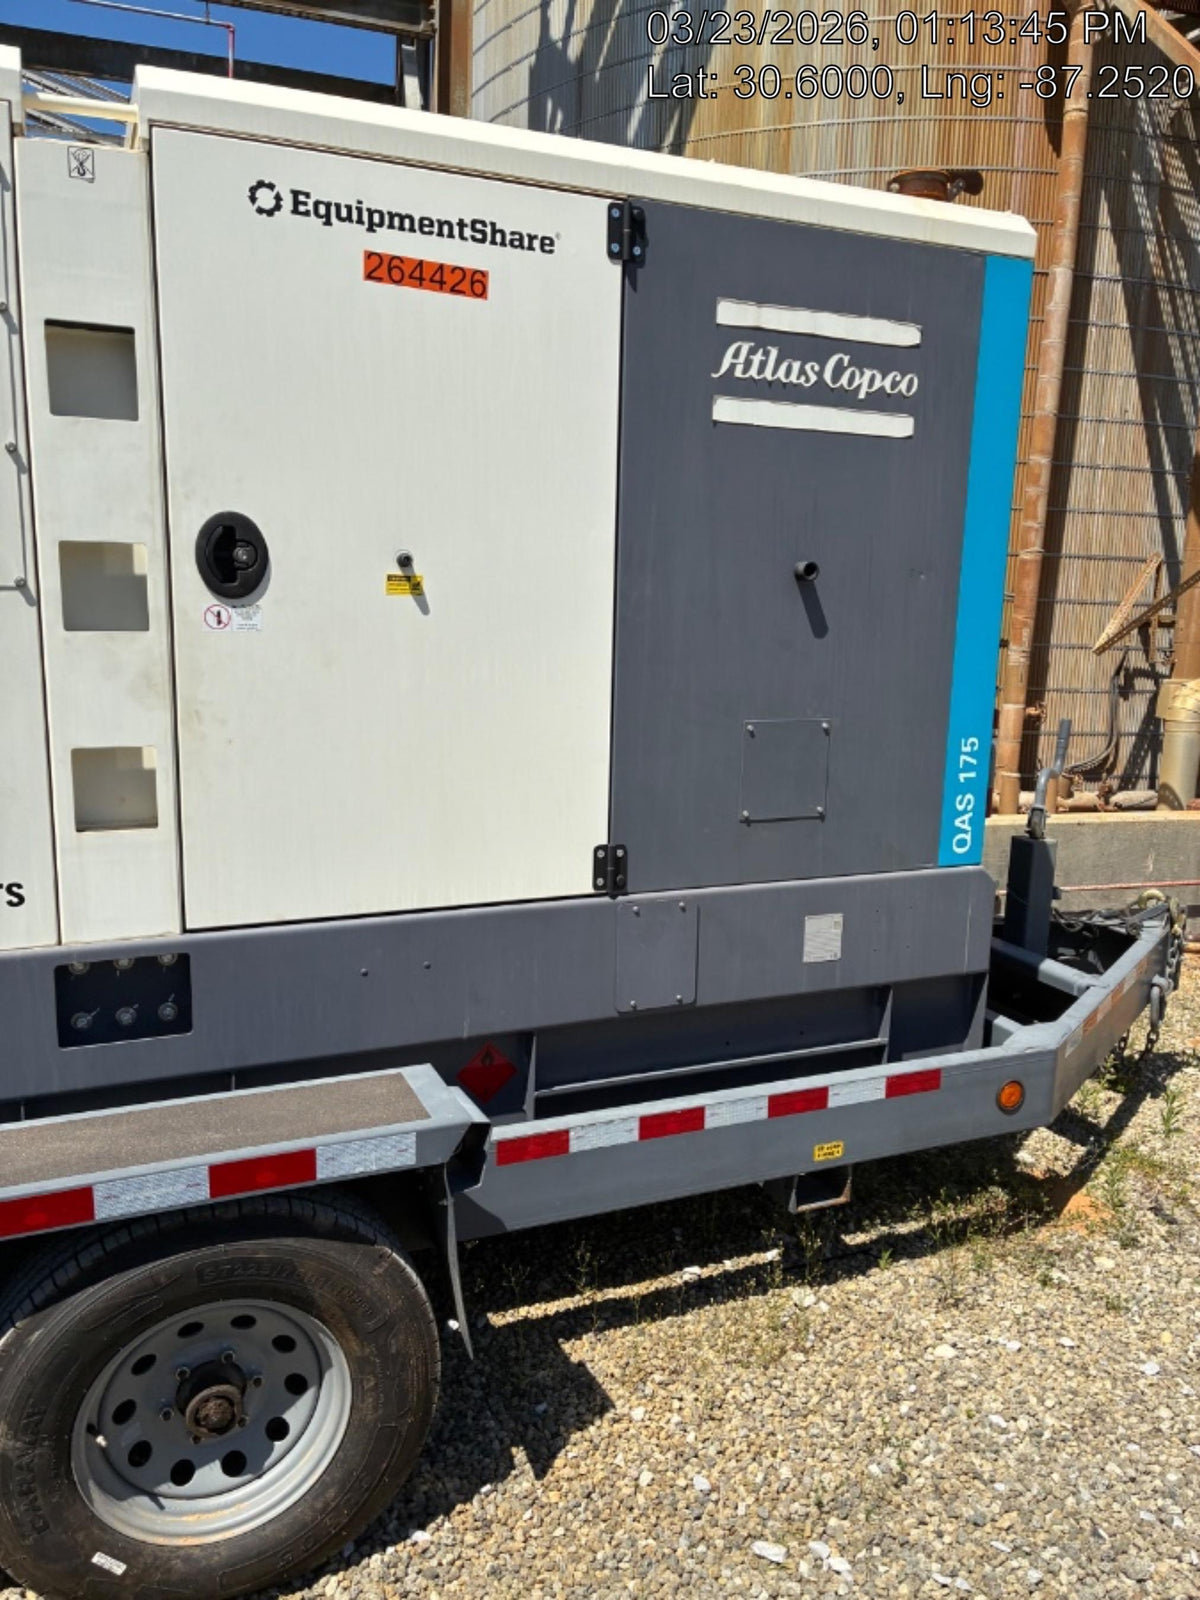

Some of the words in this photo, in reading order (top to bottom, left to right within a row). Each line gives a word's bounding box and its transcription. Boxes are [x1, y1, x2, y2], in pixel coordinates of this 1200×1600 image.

[365, 251, 488, 298] 264426
[711, 340, 820, 387] Atlas
[823, 353, 919, 399] Copco
[958, 737, 979, 783] 175
[952, 793, 975, 854] QAS
